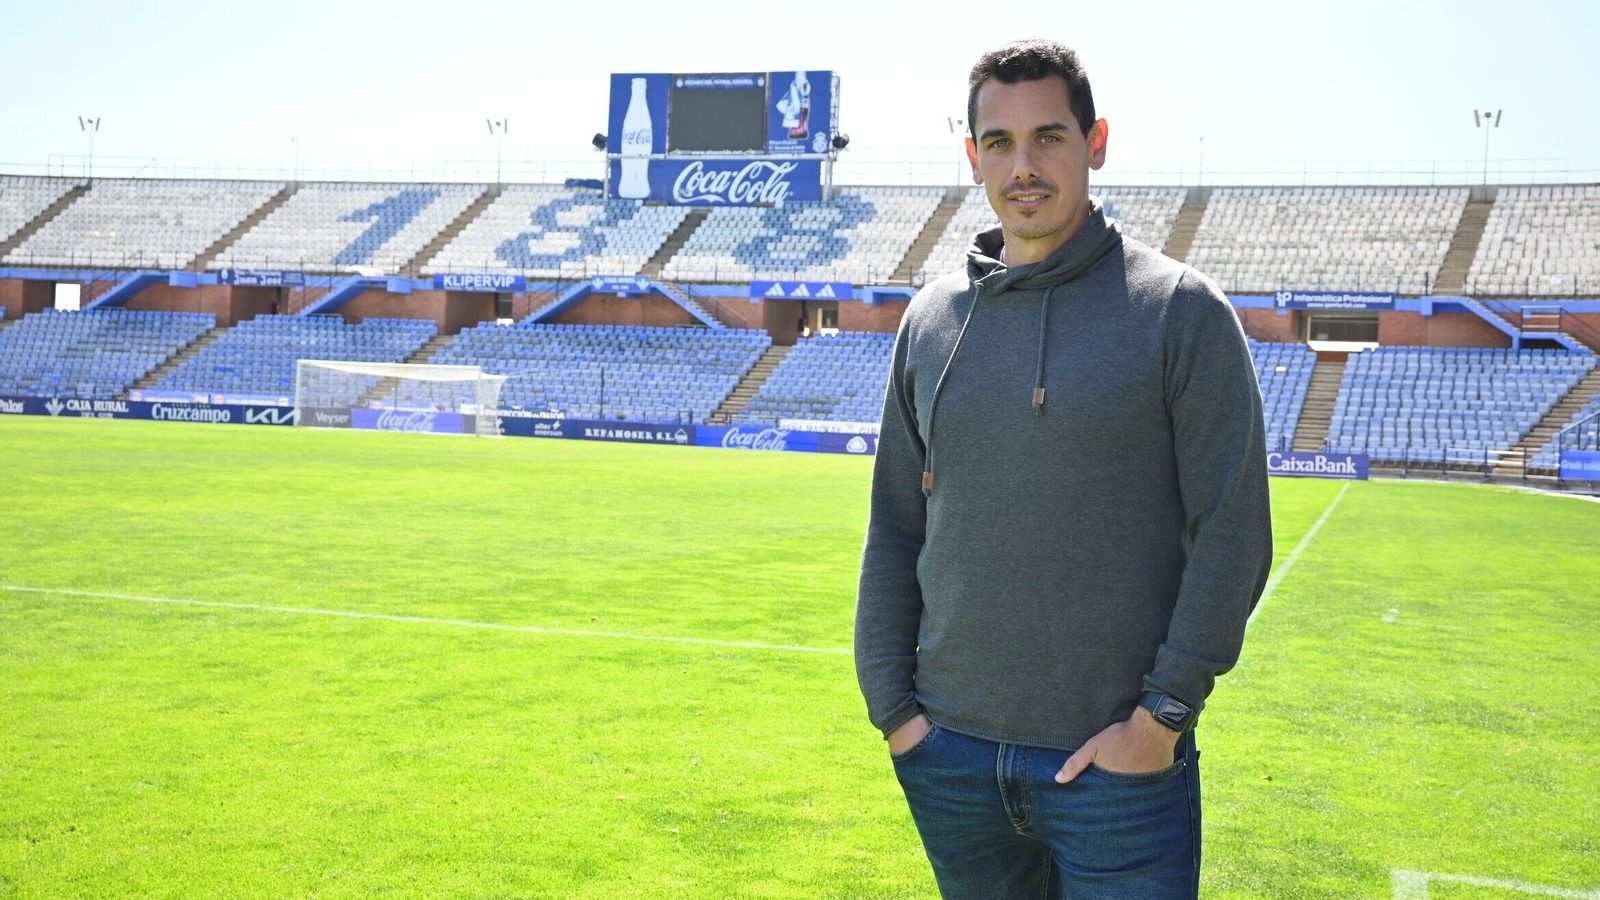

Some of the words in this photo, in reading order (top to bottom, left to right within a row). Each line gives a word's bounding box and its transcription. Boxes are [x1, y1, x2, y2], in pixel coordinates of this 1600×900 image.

[443, 275, 516, 288] KLIPERVIP
[66, 399, 92, 411] CAJA
[93, 401, 129, 412] RURAL
[151, 403, 231, 424] Cruzcampo
[315, 412, 349, 424] Veyser
[584, 423, 654, 440] REPAHOSER
[656, 431, 674, 441] S.L.
[1267, 453, 1357, 474] CaixaBank
